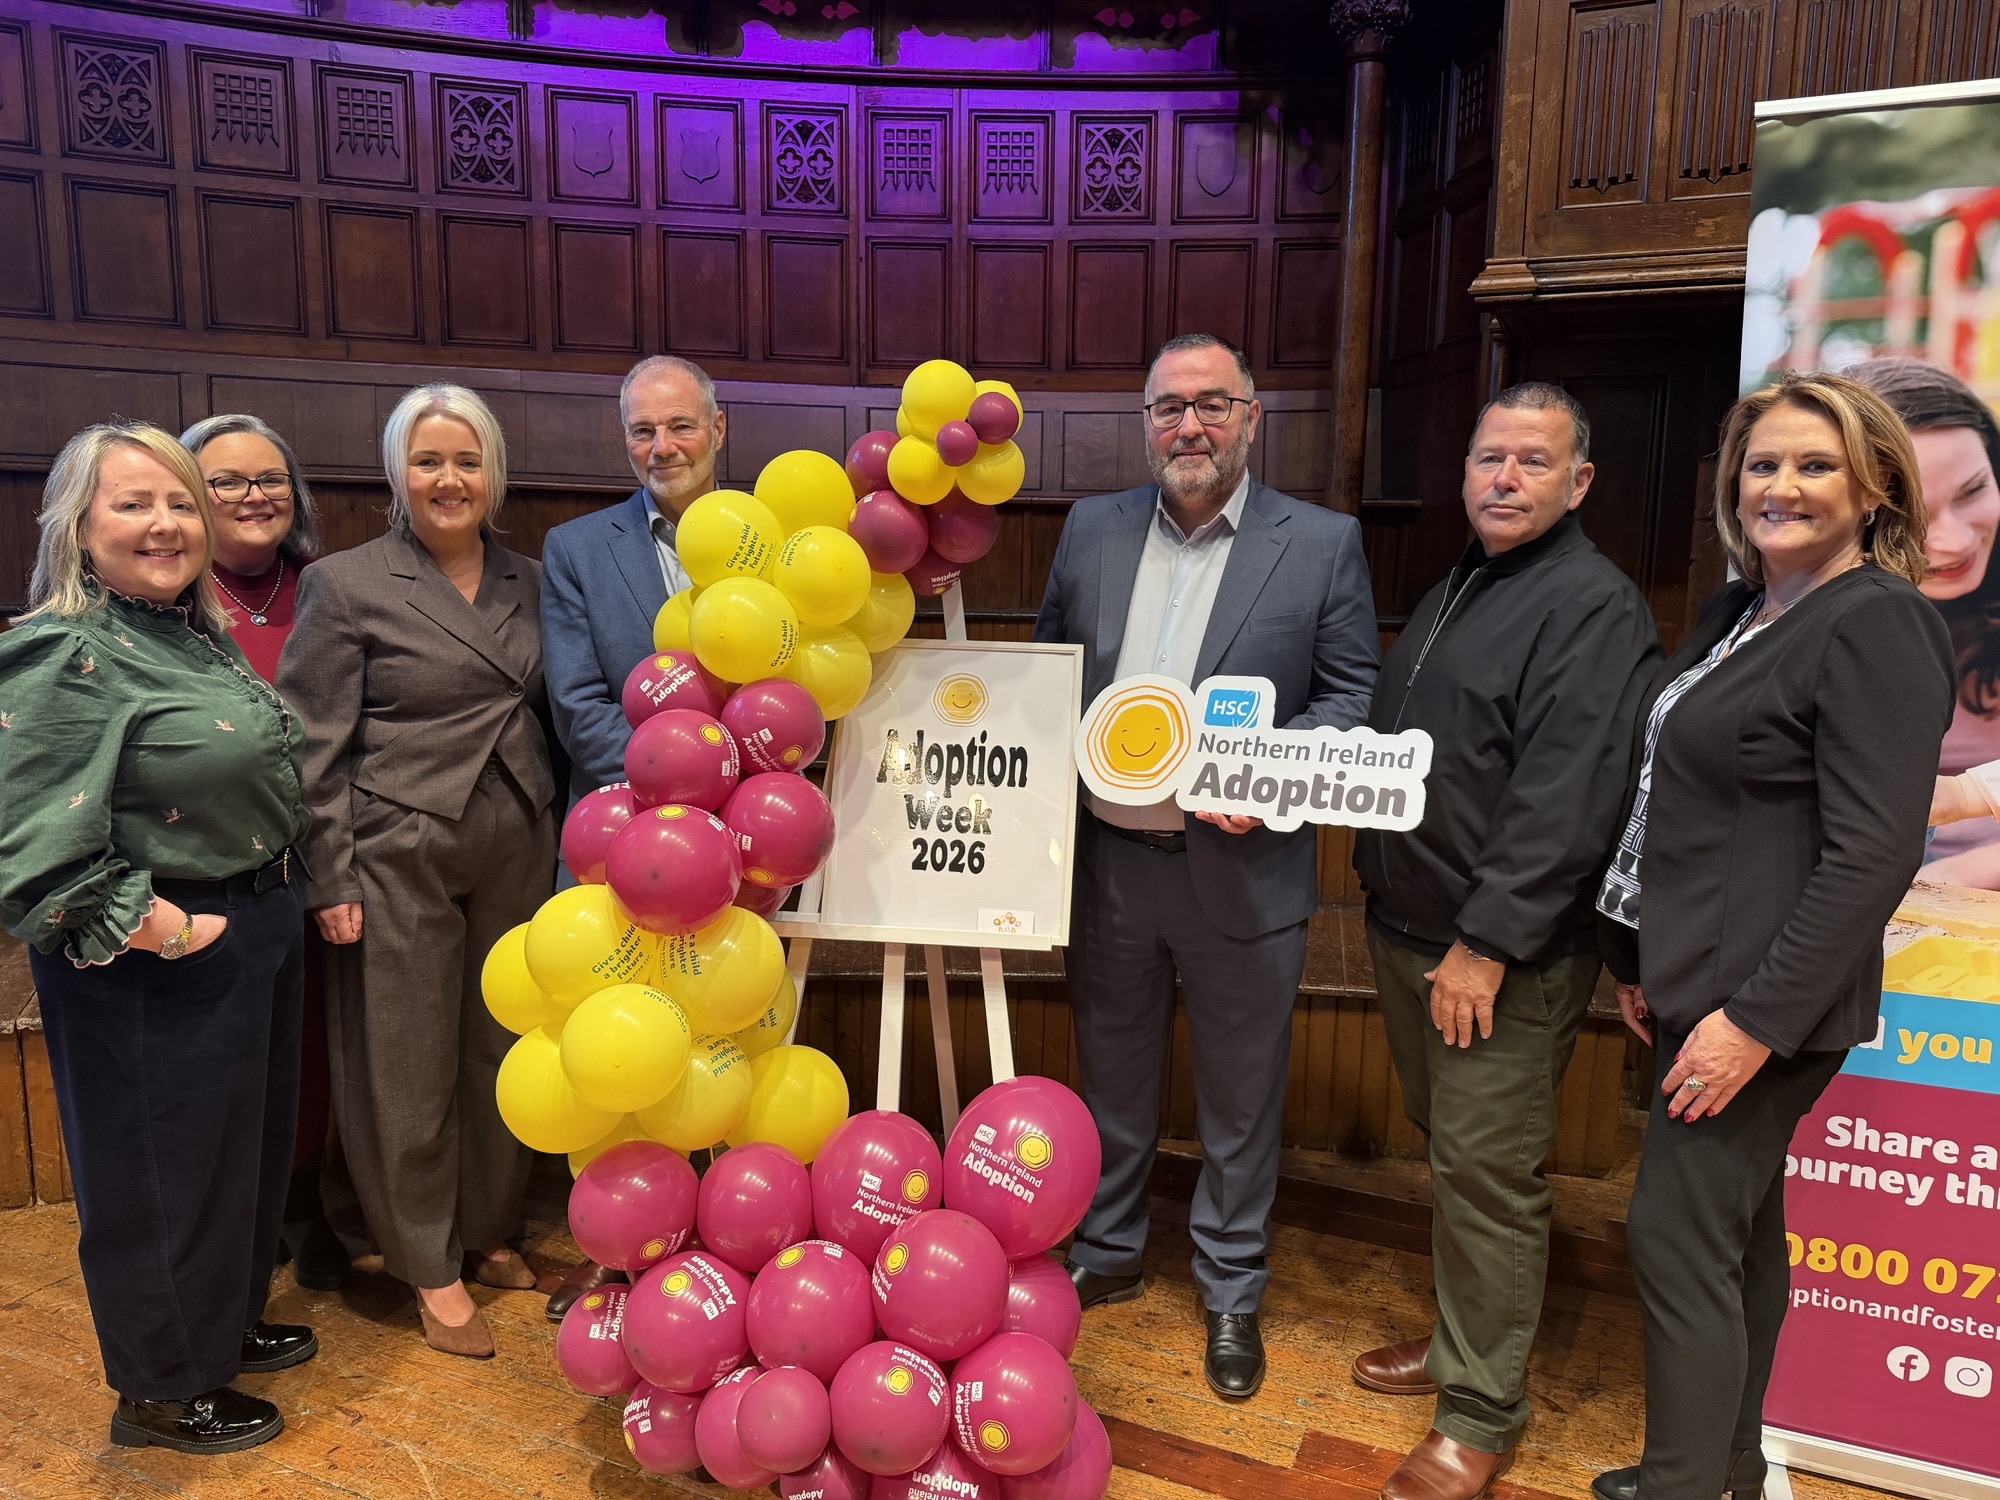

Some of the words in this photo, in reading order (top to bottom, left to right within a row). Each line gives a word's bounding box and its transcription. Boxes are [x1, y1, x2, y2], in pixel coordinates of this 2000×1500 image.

[726, 552, 741, 569] Give
[740, 524, 751, 544] child
[740, 531, 759, 566] brighter
[749, 542, 766, 570] future
[786, 548, 795, 567] child
[771, 651, 784, 667] Give
[782, 623, 793, 660] brighter
[646, 677, 669, 698] Northern
[668, 662, 688, 678] Ireland
[652, 670, 697, 707] Adoption
[1212, 700, 1250, 717] HSC
[742, 737, 772, 772] Adoptio
[752, 732, 770, 759] Northern
[1198, 732, 1311, 761] Northern
[1318, 742, 1416, 770] Ireland
[876, 729, 1028, 798] Adoption
[1189, 762, 1407, 818] Adoption
[904, 794, 993, 835] Week
[912, 838, 986, 875] 2026
[592, 954, 615, 974] Give
[620, 924, 636, 948] child
[610, 936, 642, 973] brighter
[617, 952, 644, 980] future
[690, 950, 702, 976] child
[643, 990, 667, 1004] child
[768, 1008, 777, 1028] hild
[1897, 1028, 1992, 1065] you
[712, 1060, 732, 1078] child
[978, 1128, 992, 1139] HSC
[1824, 1115, 1960, 1164] Share
[1970, 1144, 1998, 1171] a
[962, 1152, 1035, 1204] Adoption
[969, 1140, 1008, 1167] Northern
[1009, 1162, 1043, 1188] Ireland
[857, 1188, 896, 1210] Northern
[864, 1177, 877, 1187] HSC
[680, 1261, 704, 1281] Ireland
[691, 1256, 737, 1305] Adoption
[1785, 1232, 1909, 1286] 0800
[1922, 1258, 2000, 1304] 07
[703, 1277, 727, 1313] Northern
[706, 1304, 716, 1317] HSC
[600, 1310, 612, 1340] Northern
[609, 1292, 628, 1342] Adoption
[891, 1354, 919, 1370] Ireland
[894, 1347, 946, 1388] Adoption
[919, 1366, 944, 1397] Northern
[628, 1410, 651, 1423] Northern
[954, 1382, 971, 1452] Adoption
[966, 1425, 981, 1453] Ireland
[908, 1488, 940, 1500] Ireland
[912, 1470, 980, 1500] Adoption
